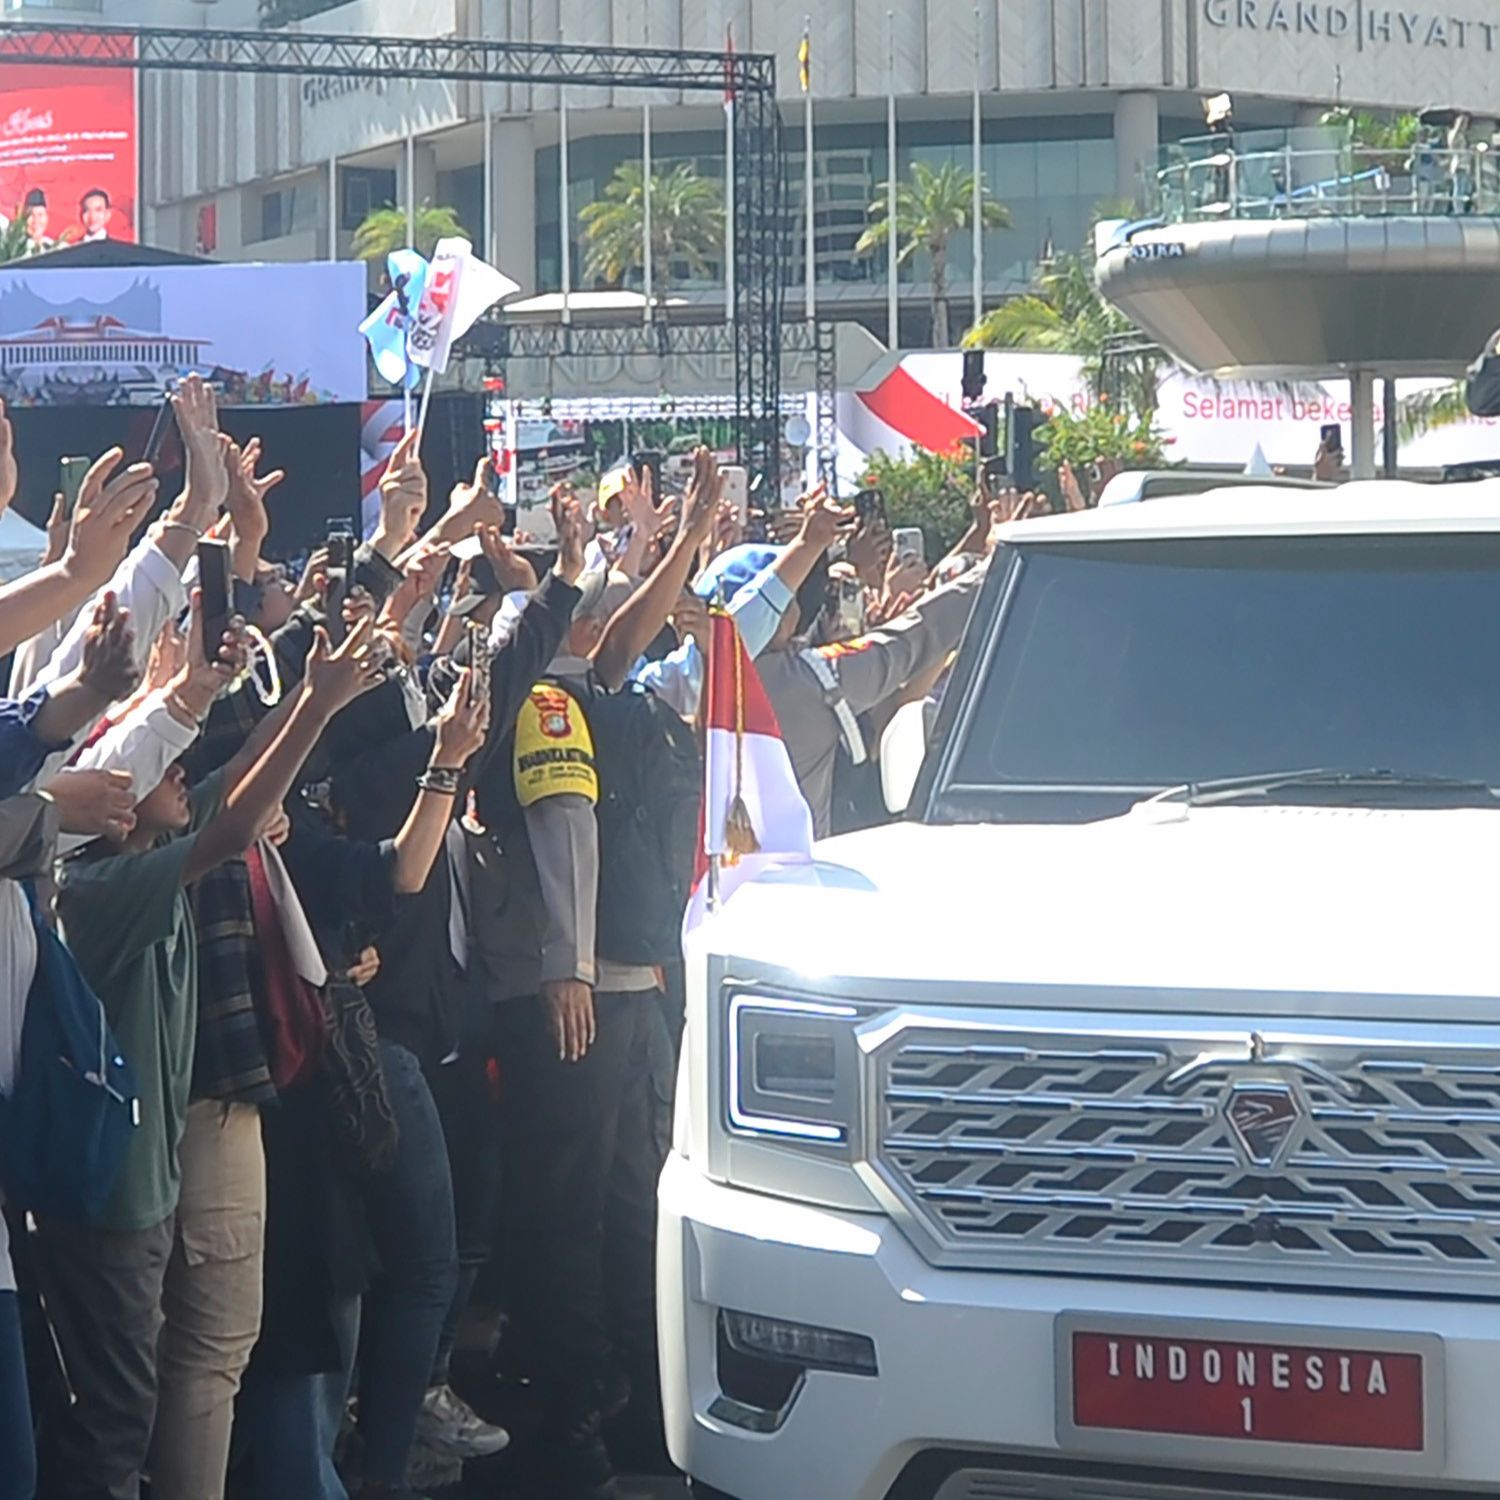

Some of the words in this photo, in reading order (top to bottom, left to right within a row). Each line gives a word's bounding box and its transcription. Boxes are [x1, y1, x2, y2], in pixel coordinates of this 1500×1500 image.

[1205, 0, 1347, 37] GRAND
[1369, 9, 1498, 52] HYATT
[1182, 391, 1283, 421] Selamat
[1293, 396, 1385, 422] bekea
[1108, 1342, 1387, 1394] INDONESIA
[1241, 1396, 1252, 1433] 1
